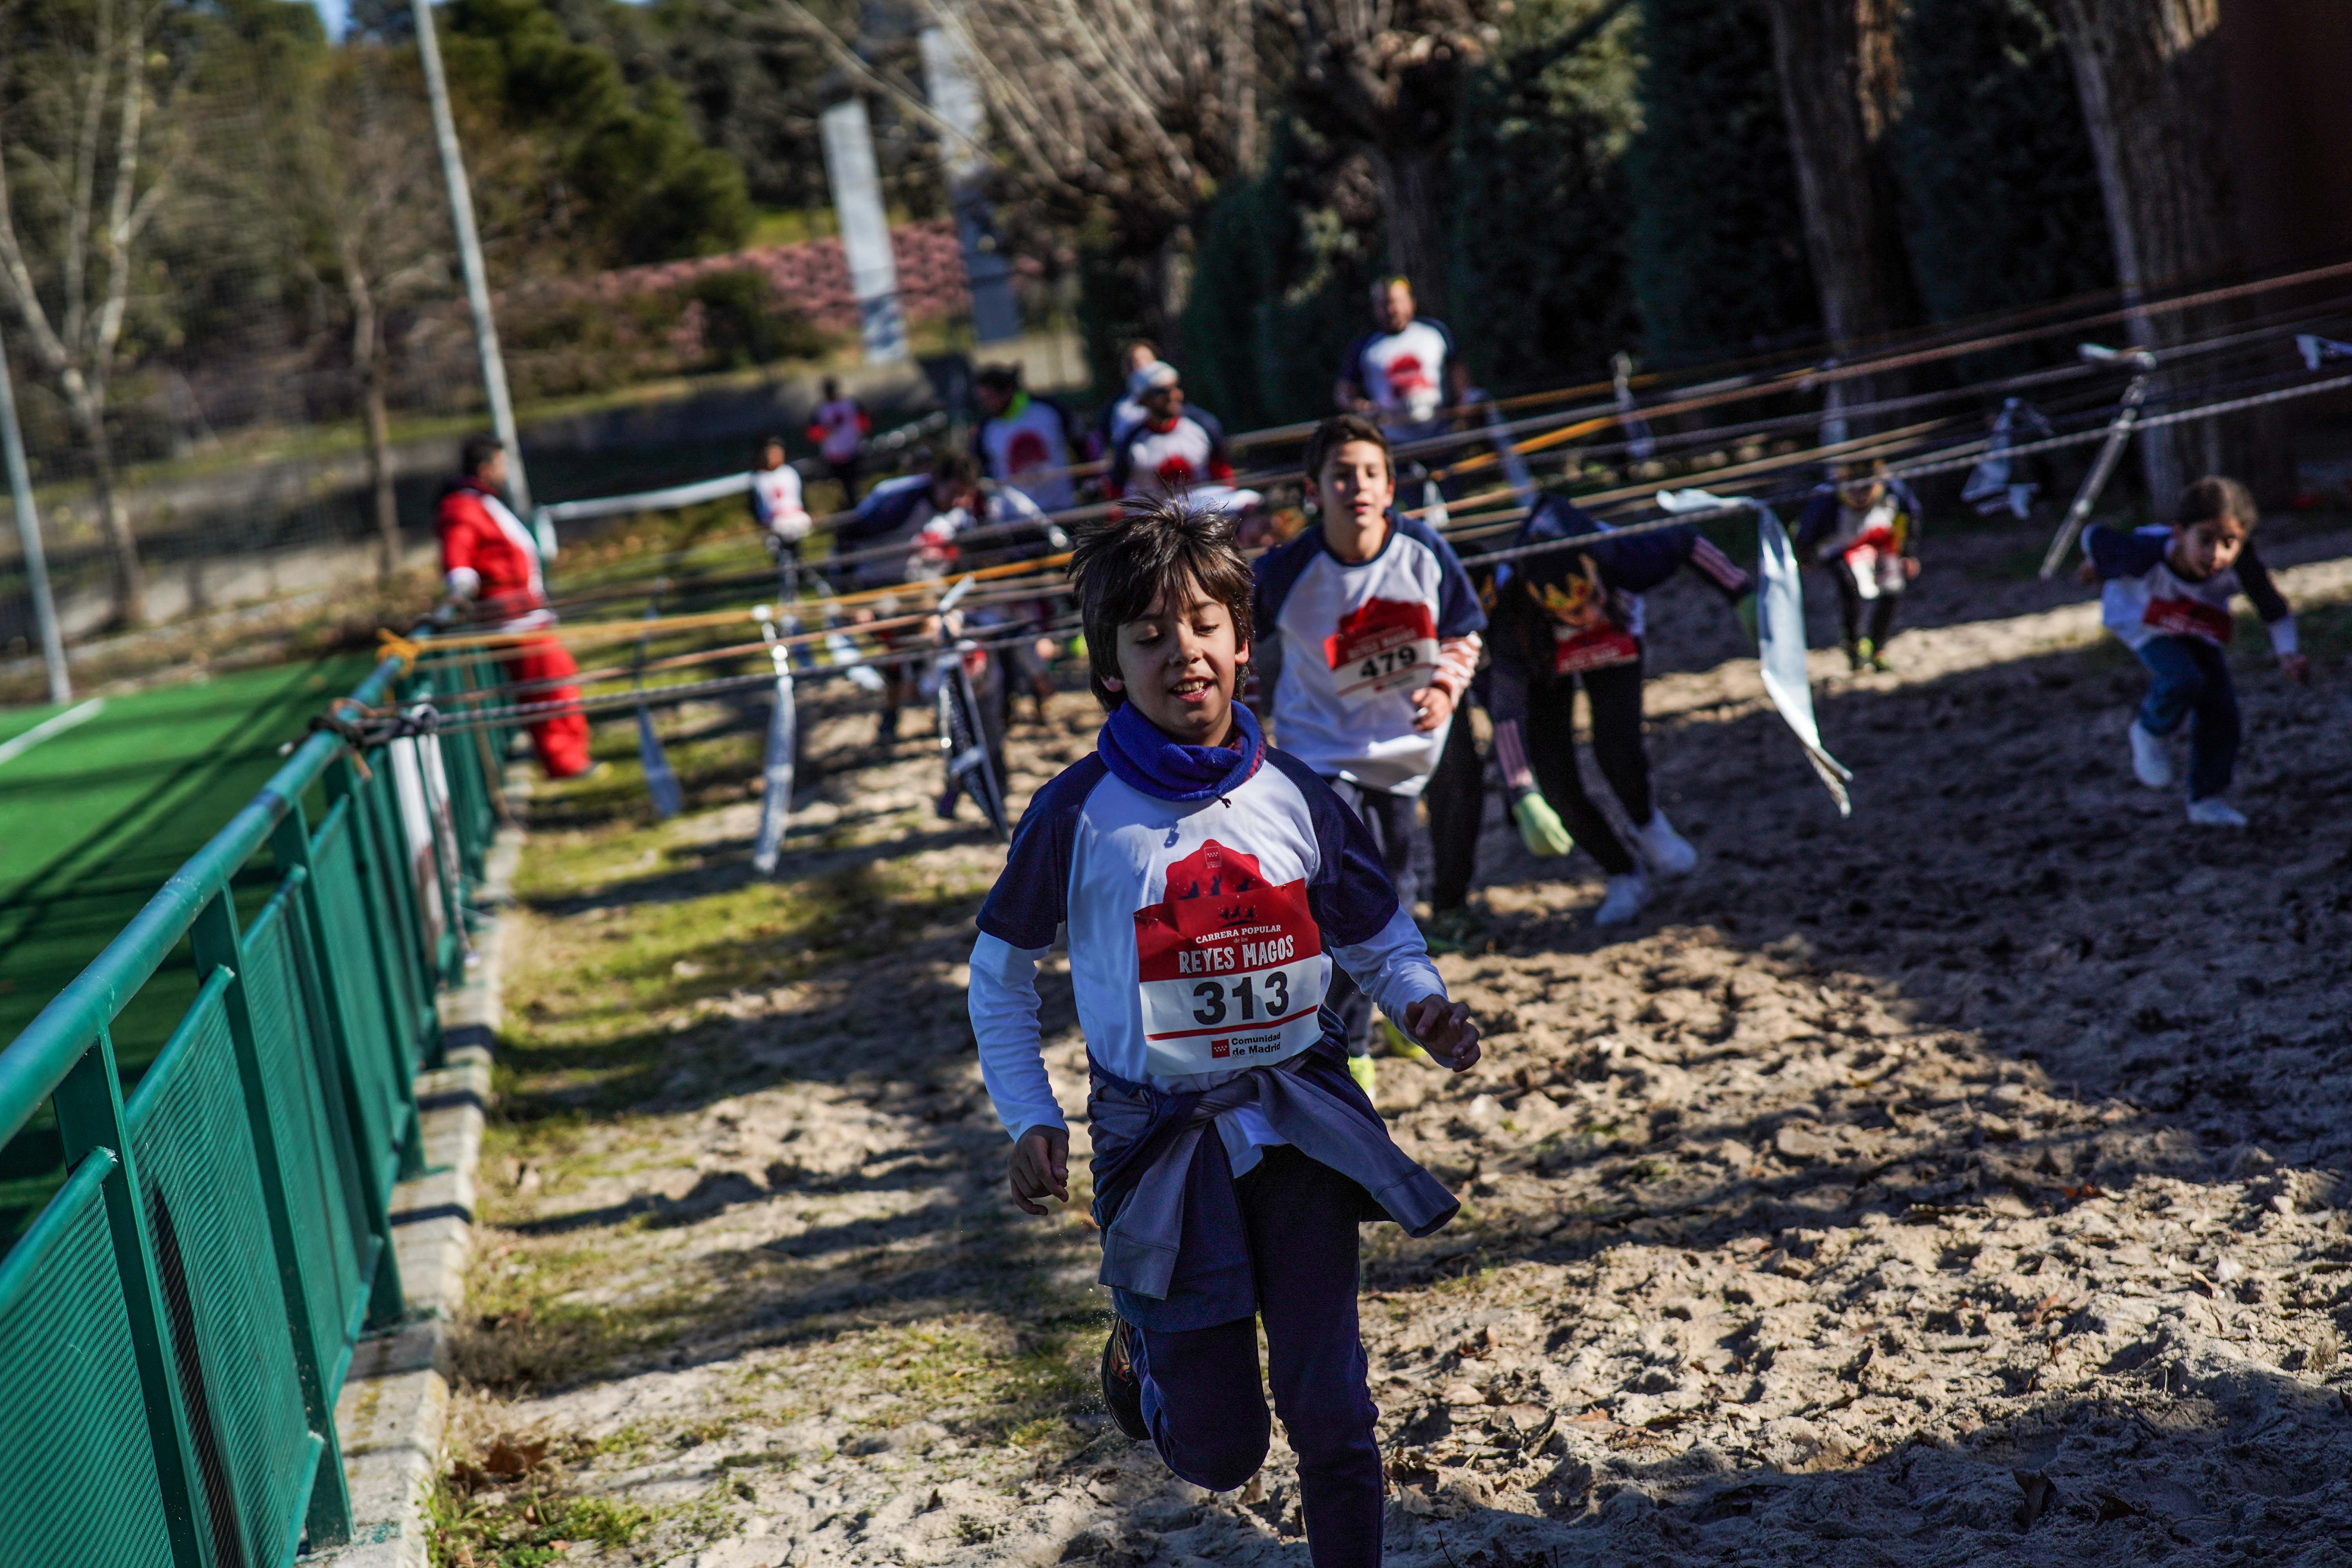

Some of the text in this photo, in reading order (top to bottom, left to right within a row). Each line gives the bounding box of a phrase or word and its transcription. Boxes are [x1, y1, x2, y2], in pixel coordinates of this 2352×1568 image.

[1360, 646, 1417, 677] 479
[1196, 925, 1281, 944] CARRERA POPULAR
[1178, 935, 1294, 974] REYES MAGOS
[1193, 971, 1289, 1025] 313
[1231, 1032, 1281, 1045] Comunidad
[1249, 1042, 1281, 1054] Madrid
